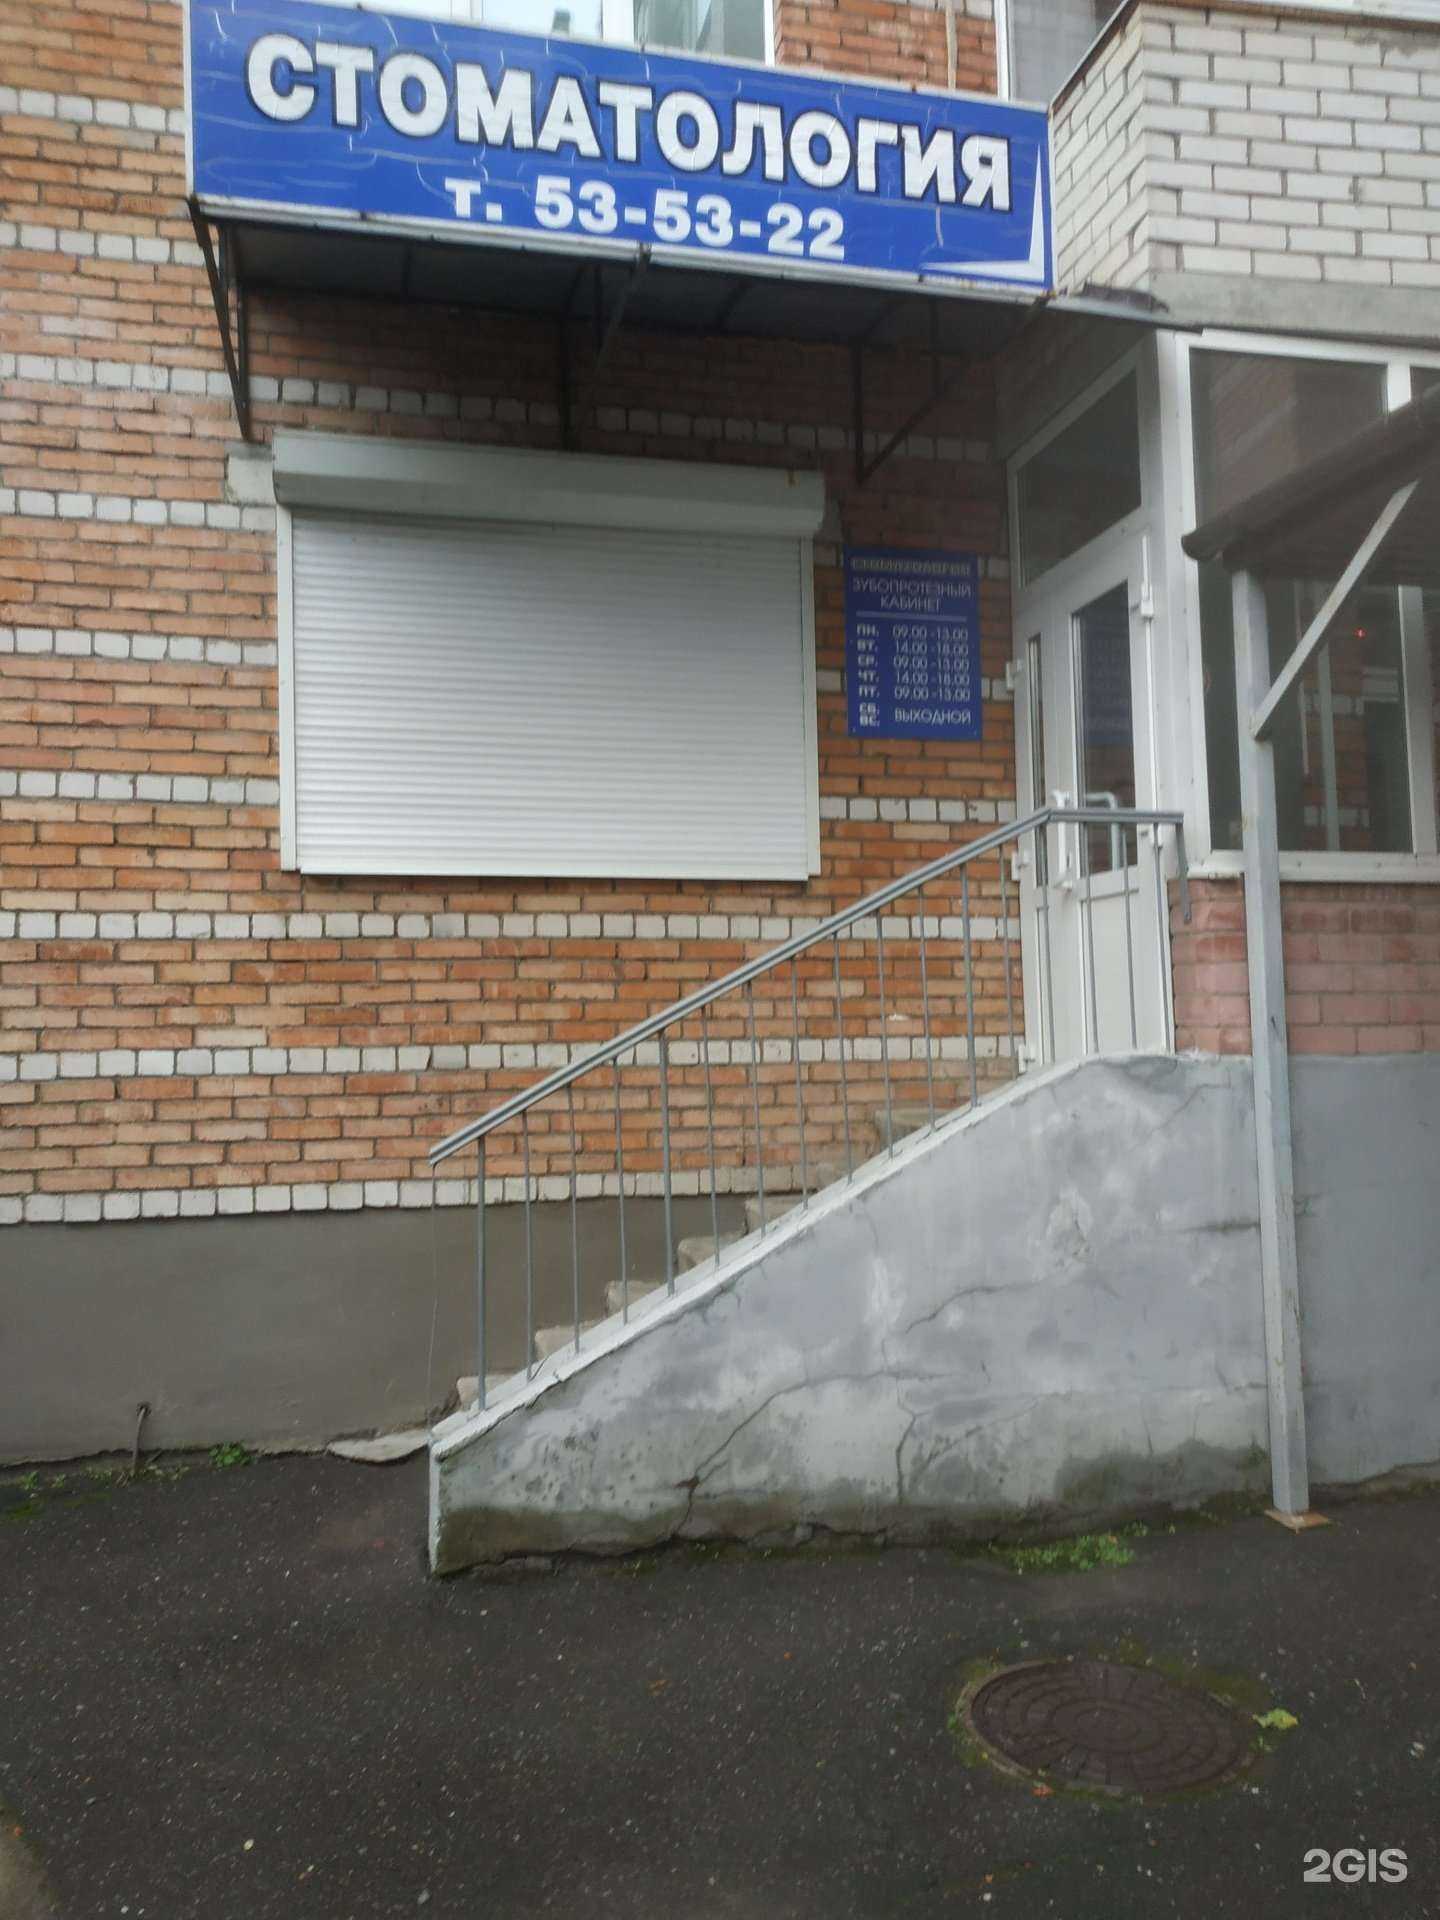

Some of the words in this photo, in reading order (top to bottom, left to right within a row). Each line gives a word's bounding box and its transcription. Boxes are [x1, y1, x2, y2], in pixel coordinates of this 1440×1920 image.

[246, 33, 1012, 213] СТОМАТОЛОГИЯ
[534, 175, 845, 261] 53-53-22
[880, 594, 941, 612] КАБИНЕТ
[894, 706, 972, 726] ВЫХОДНОЙ
